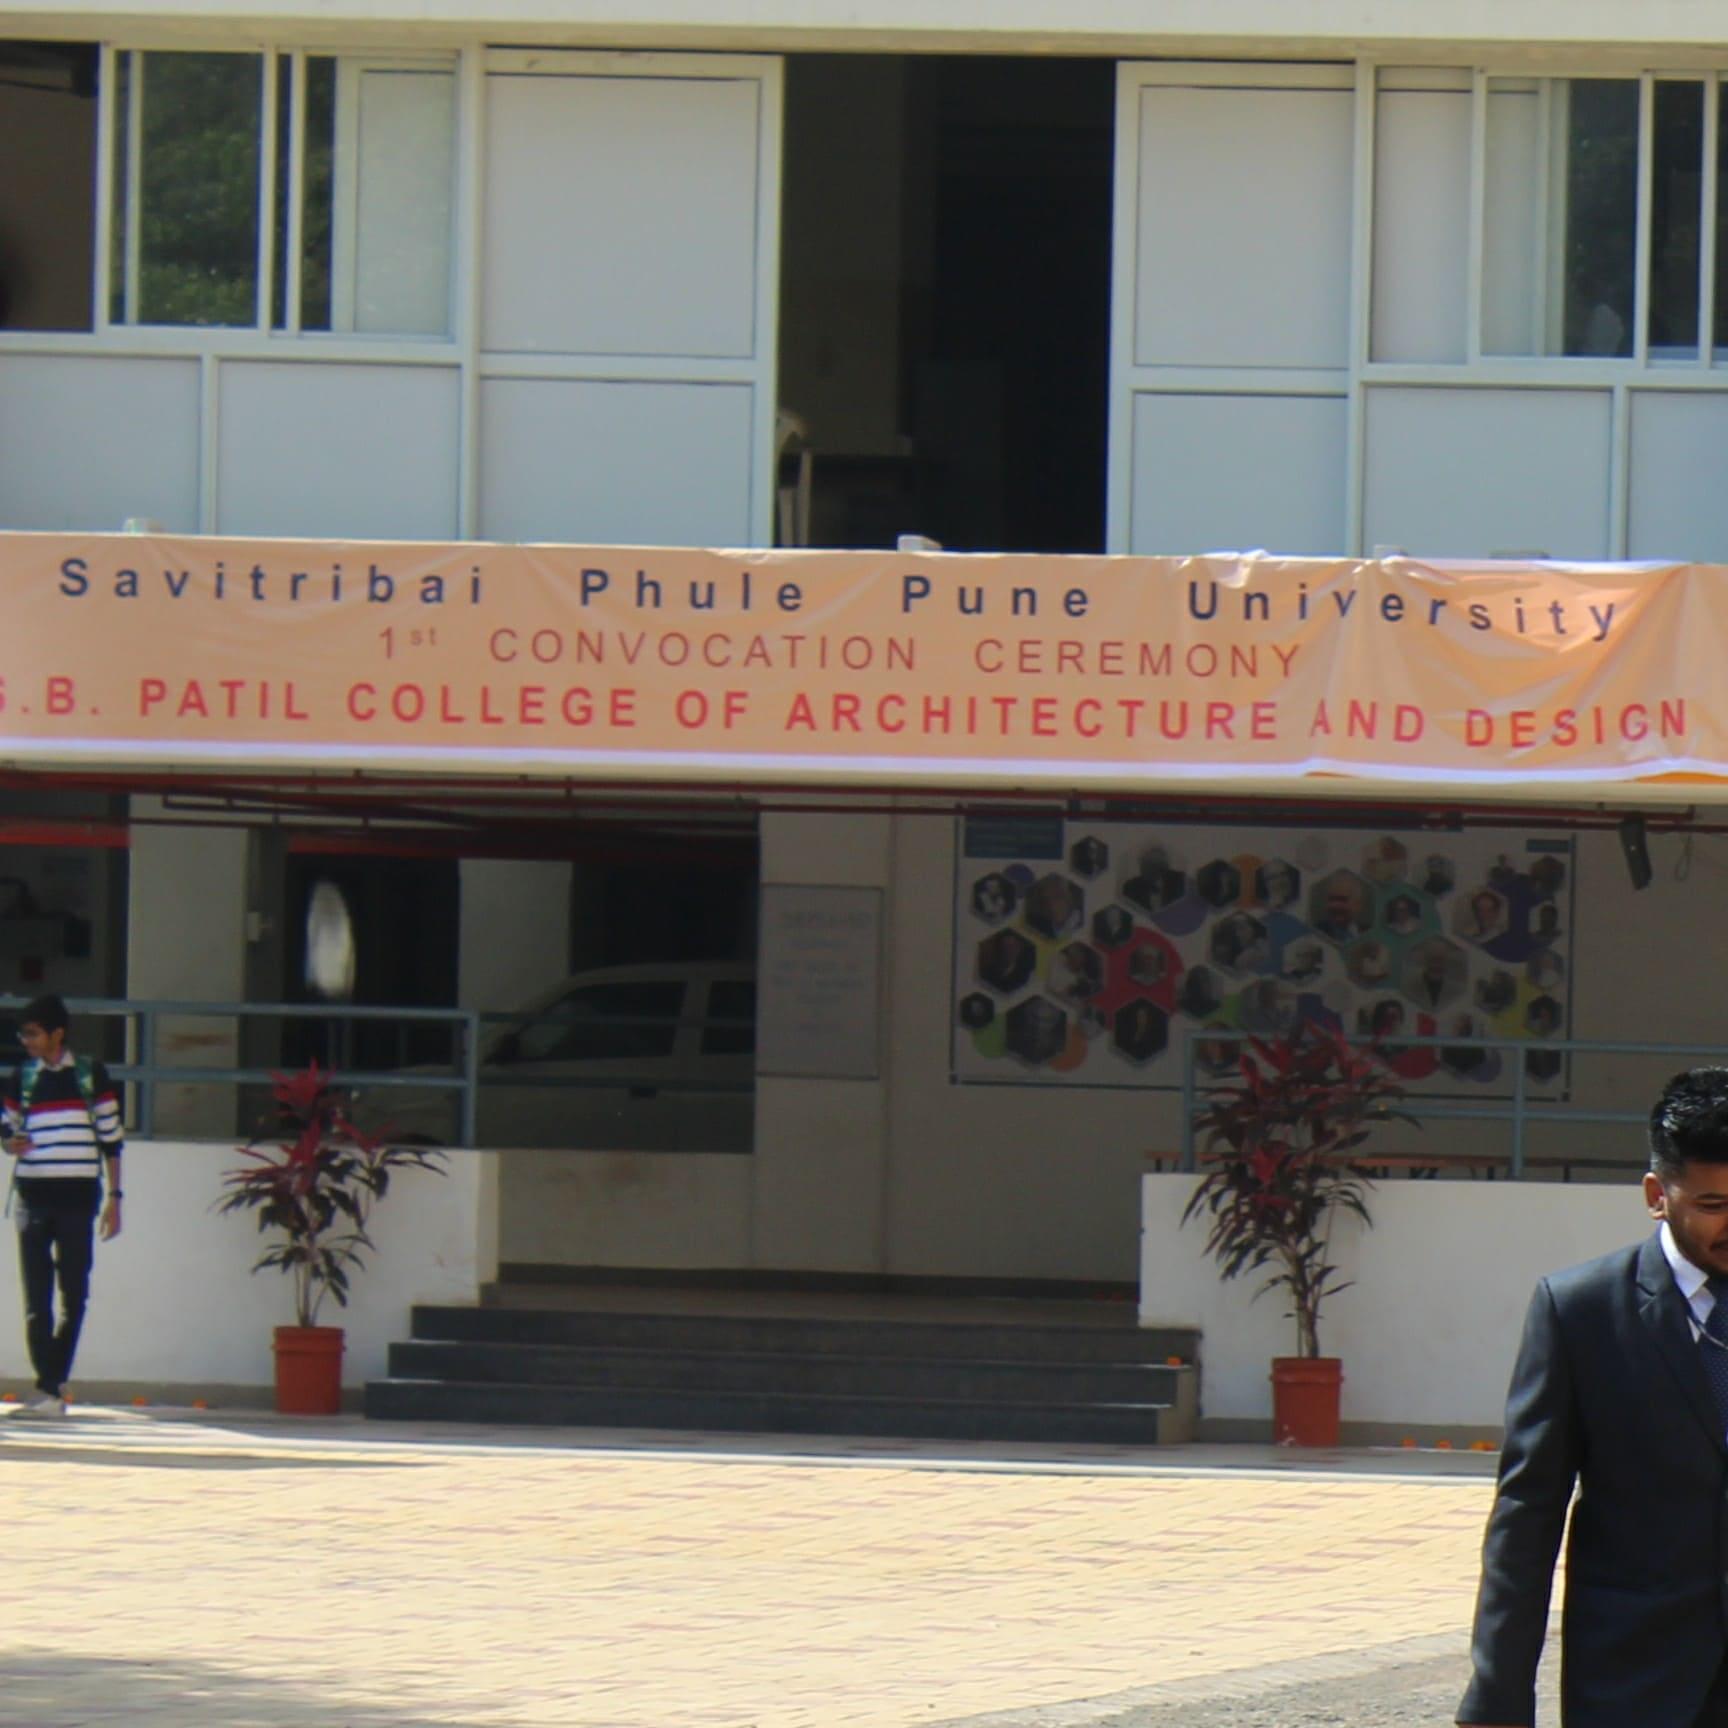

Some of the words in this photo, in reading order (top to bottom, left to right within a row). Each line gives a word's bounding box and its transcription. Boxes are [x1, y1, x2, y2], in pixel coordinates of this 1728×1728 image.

[59, 557, 481, 605] Savitribai
[580, 567, 803, 612] Phule
[901, 574, 1089, 618] Pune
[1188, 580, 1615, 642] University
[380, 627, 438, 660] 1st
[489, 628, 914, 671] CONVOCATION
[975, 638, 1299, 678] CEREMONY
[0, 674, 100, 716] .B.
[140, 677, 310, 721] PATIL
[346, 682, 636, 728] COLLEGE
[675, 689, 749, 730] OF
[783, 692, 1278, 741] ARCHITECTURE
[1310, 699, 1425, 743] AND
[1465, 698, 1686, 749] DESIGN
